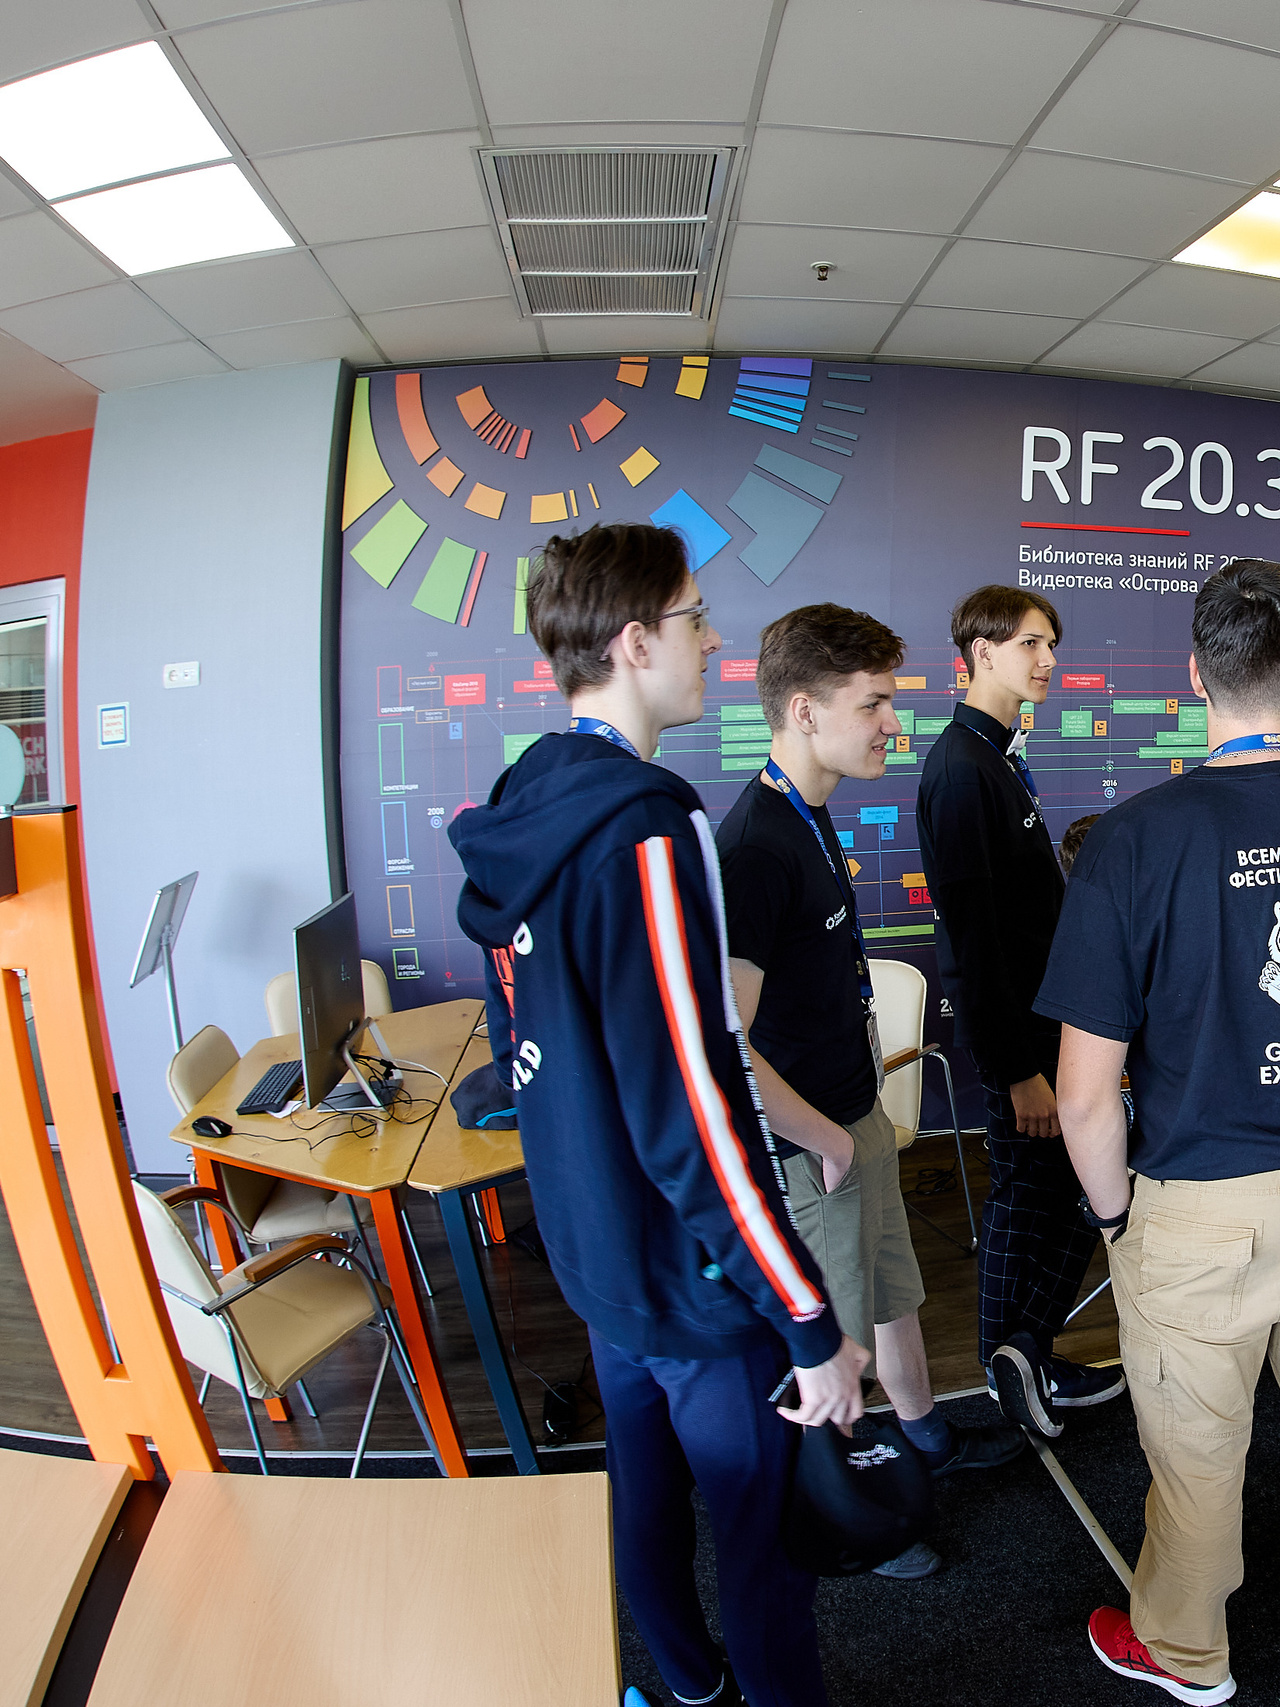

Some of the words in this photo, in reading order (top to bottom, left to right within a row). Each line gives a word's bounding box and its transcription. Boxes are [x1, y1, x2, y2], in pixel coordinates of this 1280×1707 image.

[1021, 426, 1124, 505] RF
[1019, 544, 1124, 567] Библиотека
[1129, 551, 1188, 571] знаний
[1194, 553, 1215, 571] RF
[1018, 568, 1113, 590] Видеотека
[1119, 573, 1198, 595] «Острова
[380, 705, 415, 713] ОБРАЗОВАНИЕ
[383, 784, 419, 792] КОМПЕТЕНЦИИ
[427, 807, 445, 816] 2008
